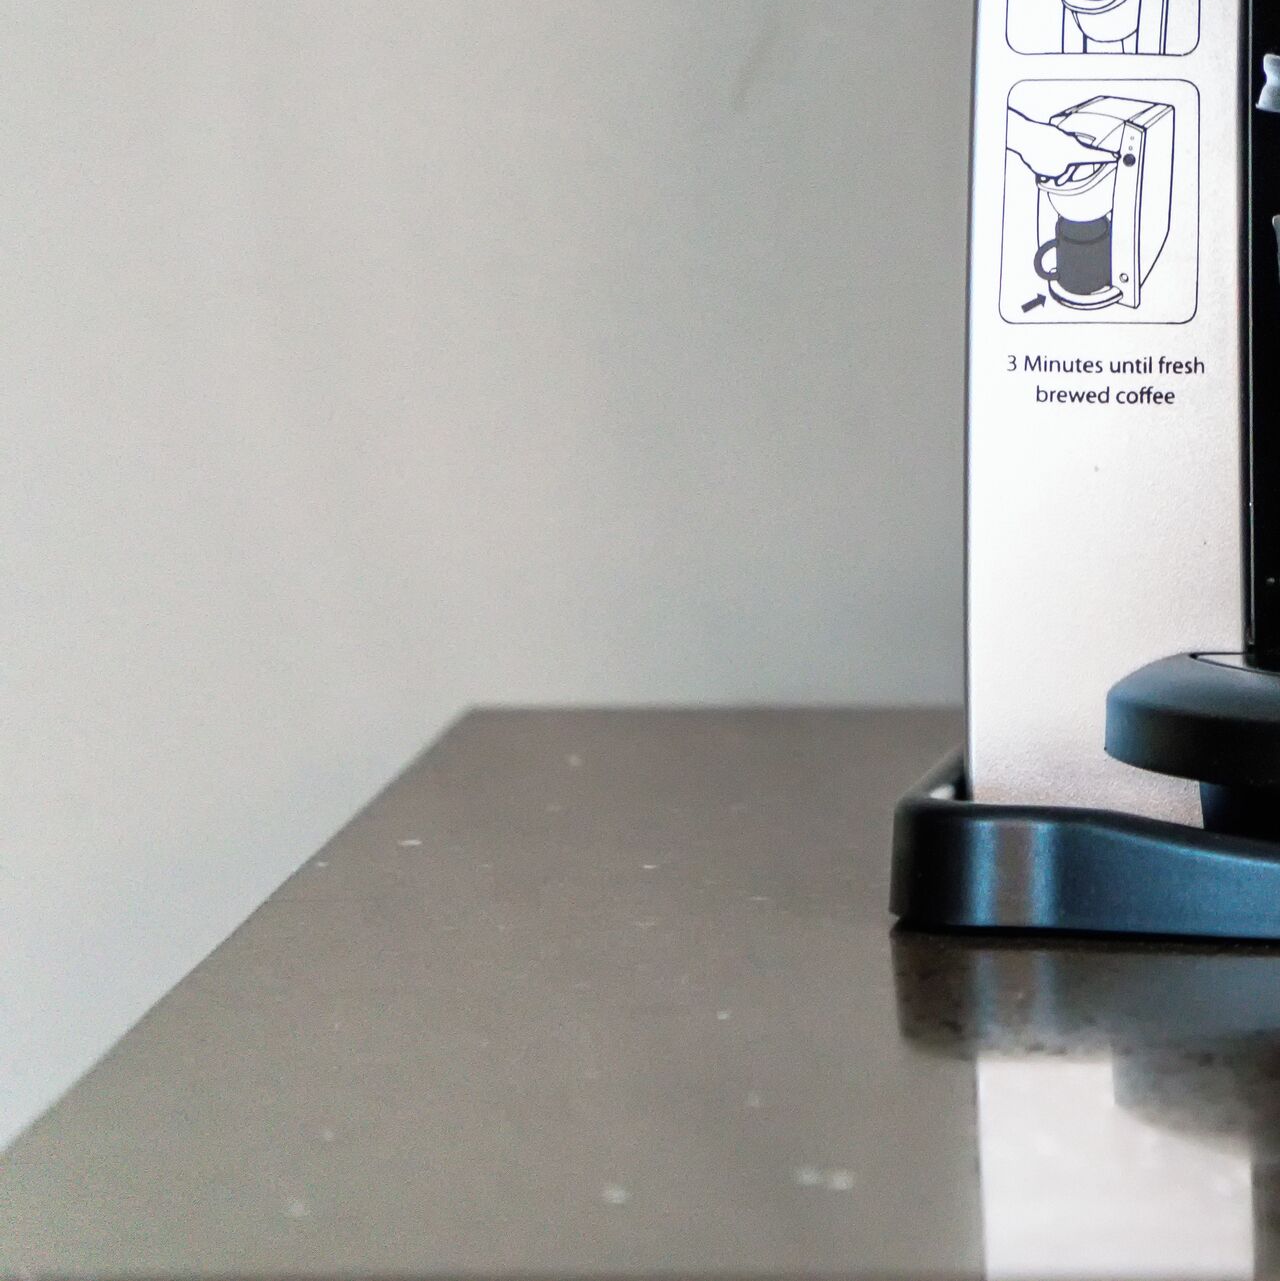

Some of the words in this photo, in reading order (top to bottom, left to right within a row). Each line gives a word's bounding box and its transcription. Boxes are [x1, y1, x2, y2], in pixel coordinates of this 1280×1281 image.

[1007, 355, 1017, 371] 3
[1024, 355, 1103, 373] Minutes
[1110, 356, 1152, 374] until
[1158, 356, 1205, 374] fresh
[1036, 385, 1110, 404] brewed
[1116, 386, 1176, 405] coffee
